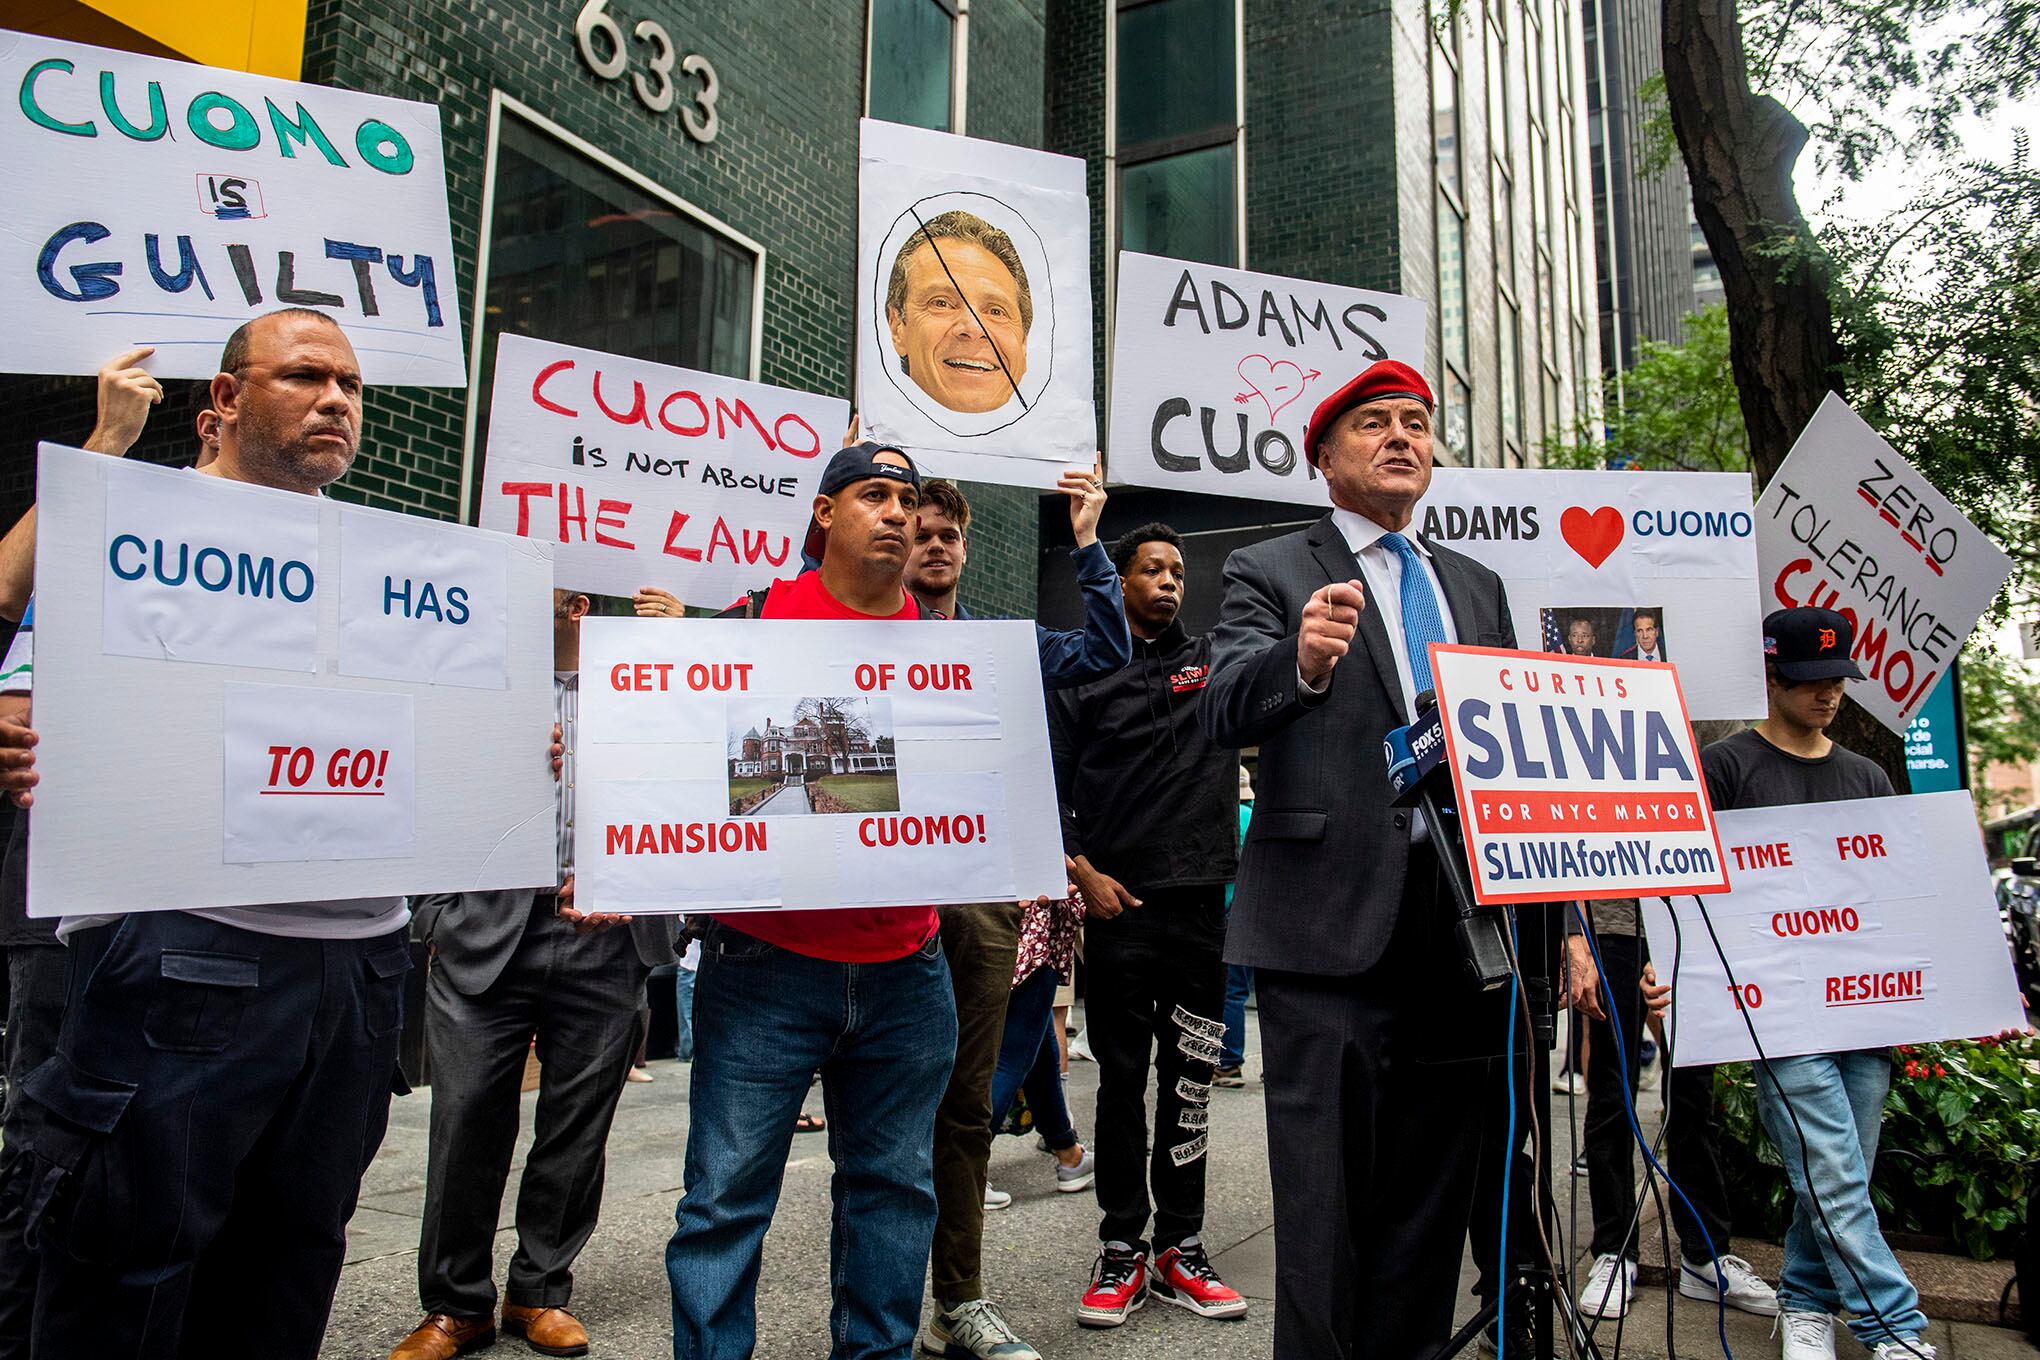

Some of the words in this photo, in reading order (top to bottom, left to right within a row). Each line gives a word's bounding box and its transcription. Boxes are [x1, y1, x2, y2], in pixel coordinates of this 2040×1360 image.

[575, 0, 719, 143] 633
[19, 58, 414, 175] CUOMO
[208, 176, 247, 208] IS
[37, 221, 443, 328] GUILTY
[1163, 268, 1389, 361] ADAMS
[532, 359, 821, 459] CUOMO
[1151, 397, 1318, 480] CUO
[625, 452, 690, 479] NOT
[501, 481, 636, 551] THE
[662, 510, 791, 568] LAW
[1422, 505, 1540, 541] ADAMS
[1632, 510, 1752, 538] CUOMO
[1858, 458, 1957, 565] ZERO
[109, 534, 314, 603] CUOMO
[383, 575, 470, 625] HAS
[1772, 482, 1957, 664] TOLERANCE
[610, 663, 674, 692] GET
[687, 663, 753, 691] OUT
[854, 663, 895, 691] OF
[907, 663, 973, 691] OUR
[1499, 669, 1627, 699] CURTIS
[1458, 698, 1694, 781] SLIWA
[268, 746, 315, 788] TO
[326, 747, 389, 788] GO!
[1481, 802, 1532, 821] FOR
[1550, 803, 1597, 821] NYC
[1614, 803, 1696, 821] MAYOR
[606, 821, 767, 855] MANSION
[858, 814, 987, 848] CUOMO!
[1730, 842, 1793, 871] TIME
[1836, 833, 1887, 861] FOR
[1484, 839, 1715, 881] SLIWAforNY.com
[1771, 907, 1859, 938] CUOMO
[1727, 983, 1763, 1010] TO
[1826, 970, 1922, 1002] RESIGN!
